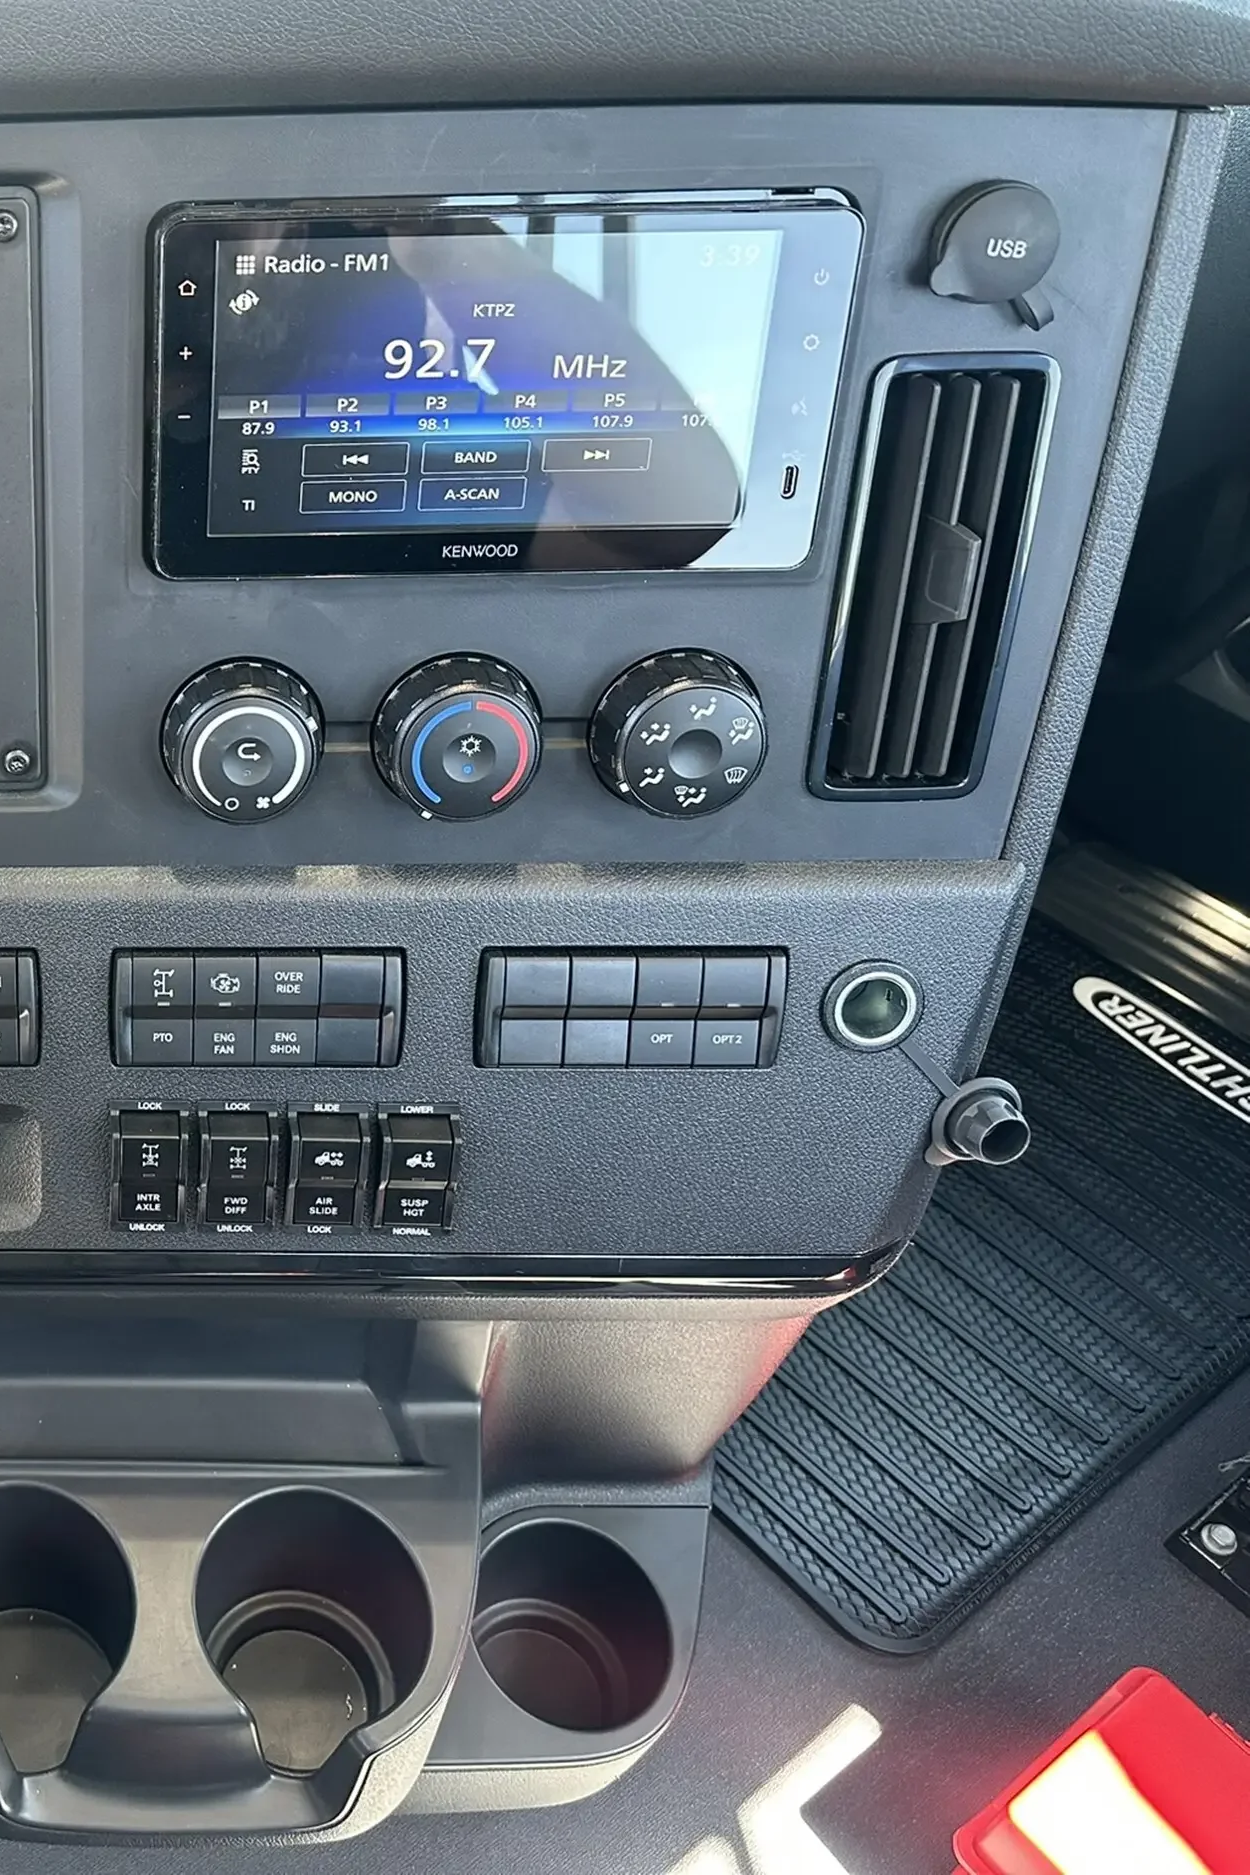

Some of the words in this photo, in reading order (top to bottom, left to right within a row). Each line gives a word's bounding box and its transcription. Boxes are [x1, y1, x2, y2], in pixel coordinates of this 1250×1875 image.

[986, 238, 1026, 258] USB
[264, 255, 325, 273] Radio
[344, 254, 389, 272] FM1
[473, 303, 515, 317] KTPZ
[384, 338, 496, 379] 92.7
[553, 354, 628, 378] MHz
[337, 399, 358, 412] P2
[426, 396, 447, 410] P3
[515, 395, 536, 408] P4
[604, 393, 625, 407] P5
[249, 400, 268, 414] P1
[329, 420, 362, 433] 93.1
[418, 418, 449, 431] 98.1
[503, 416, 543, 429] 105.1
[592, 415, 633, 428] 107.9
[241, 422, 275, 435] 87.9
[454, 451, 498, 464] BAND
[329, 491, 378, 503] MONO
[444, 488, 500, 501] A-SCAN
[442, 544, 519, 558] KENWOOD
[274, 972, 303, 983] OVER
[276, 984, 301, 994] RIDE
[153, 1033, 173, 1043] PTO
[213, 1033, 235, 1043] ENG
[274, 1032, 297, 1043] ENG
[650, 1033, 673, 1045] OPT
[712, 1034, 734, 1045] OPT
[735, 1034, 743, 1045] 2
[214, 1045, 234, 1055] FAN
[270, 1044, 301, 1055] SHDN
[138, 1102, 163, 1110] LOCK
[225, 1102, 250, 1111] LOCK
[314, 1104, 340, 1112] SLIDE
[401, 1105, 434, 1114] LOWER
[136, 1194, 160, 1202] INTR
[223, 1197, 248, 1205] FWD
[315, 1197, 333, 1205] AIR
[401, 1199, 429, 1207] SUSP
[135, 1203, 162, 1211] AXLE
[224, 1206, 247, 1214] DIFF
[309, 1207, 338, 1215] SLIDE
[403, 1209, 425, 1217] HGT
[129, 1223, 166, 1232] UNLOCK
[216, 1224, 253, 1233] UNLOCK
[307, 1226, 332, 1234] LOCK
[392, 1227, 431, 1236] NORMAL
